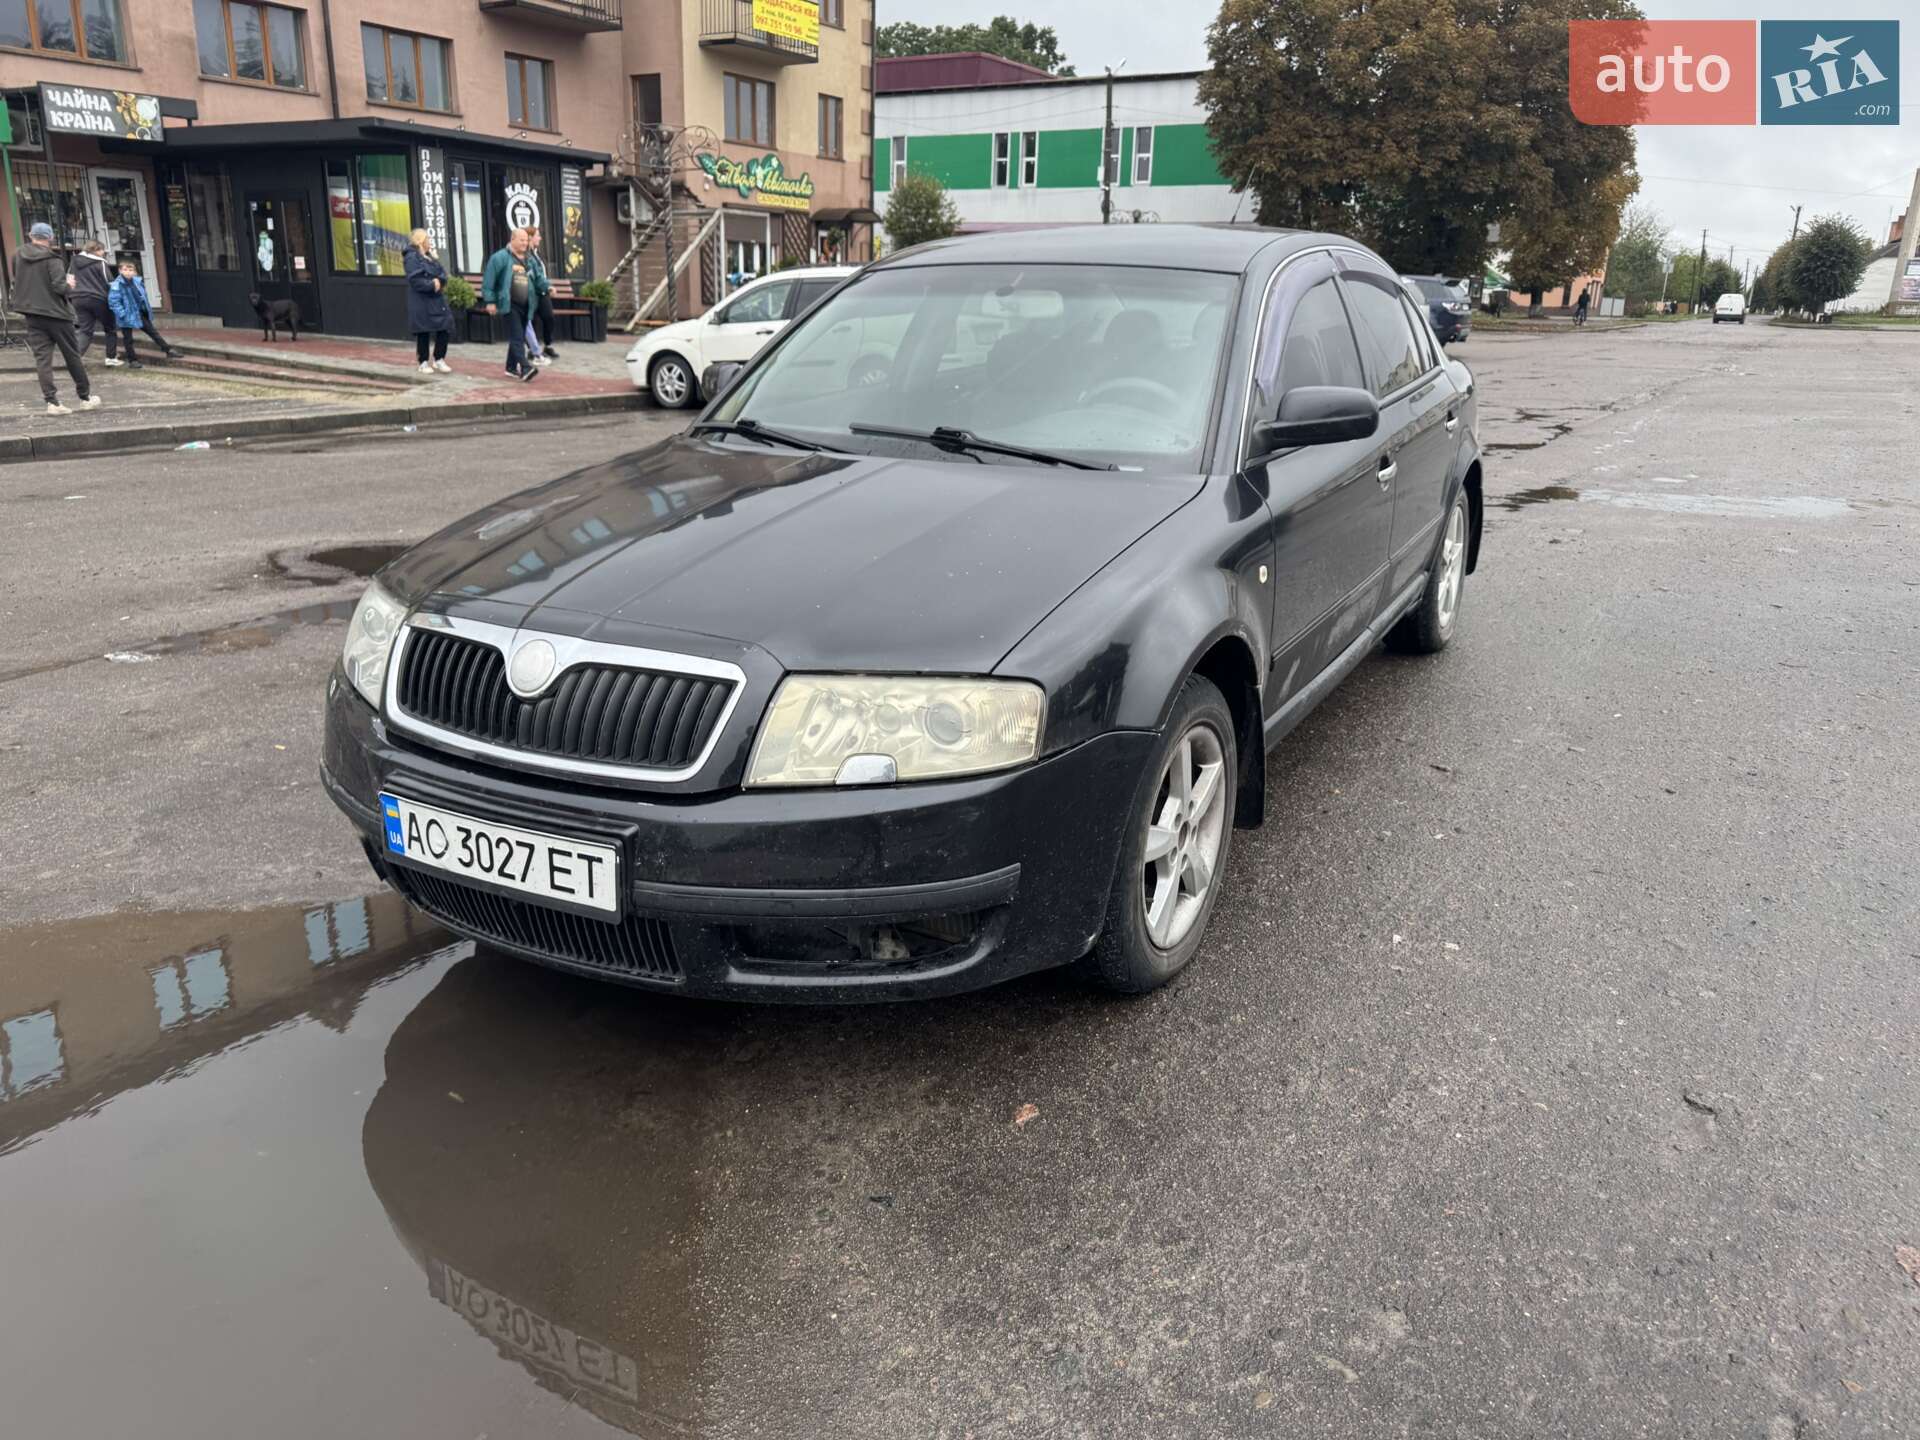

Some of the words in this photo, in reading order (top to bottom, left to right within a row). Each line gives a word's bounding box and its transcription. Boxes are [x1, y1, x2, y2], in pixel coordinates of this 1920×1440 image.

[47, 88, 113, 113] ЧАЙНА
[49, 110, 116, 132] КРАЇНА
[504, 182, 538, 202] КАВА
[432, 171, 447, 249] МАГАЗИН
[390, 830, 403, 846] UA
[456, 825, 535, 883] 3027
[548, 847, 603, 899] ET
